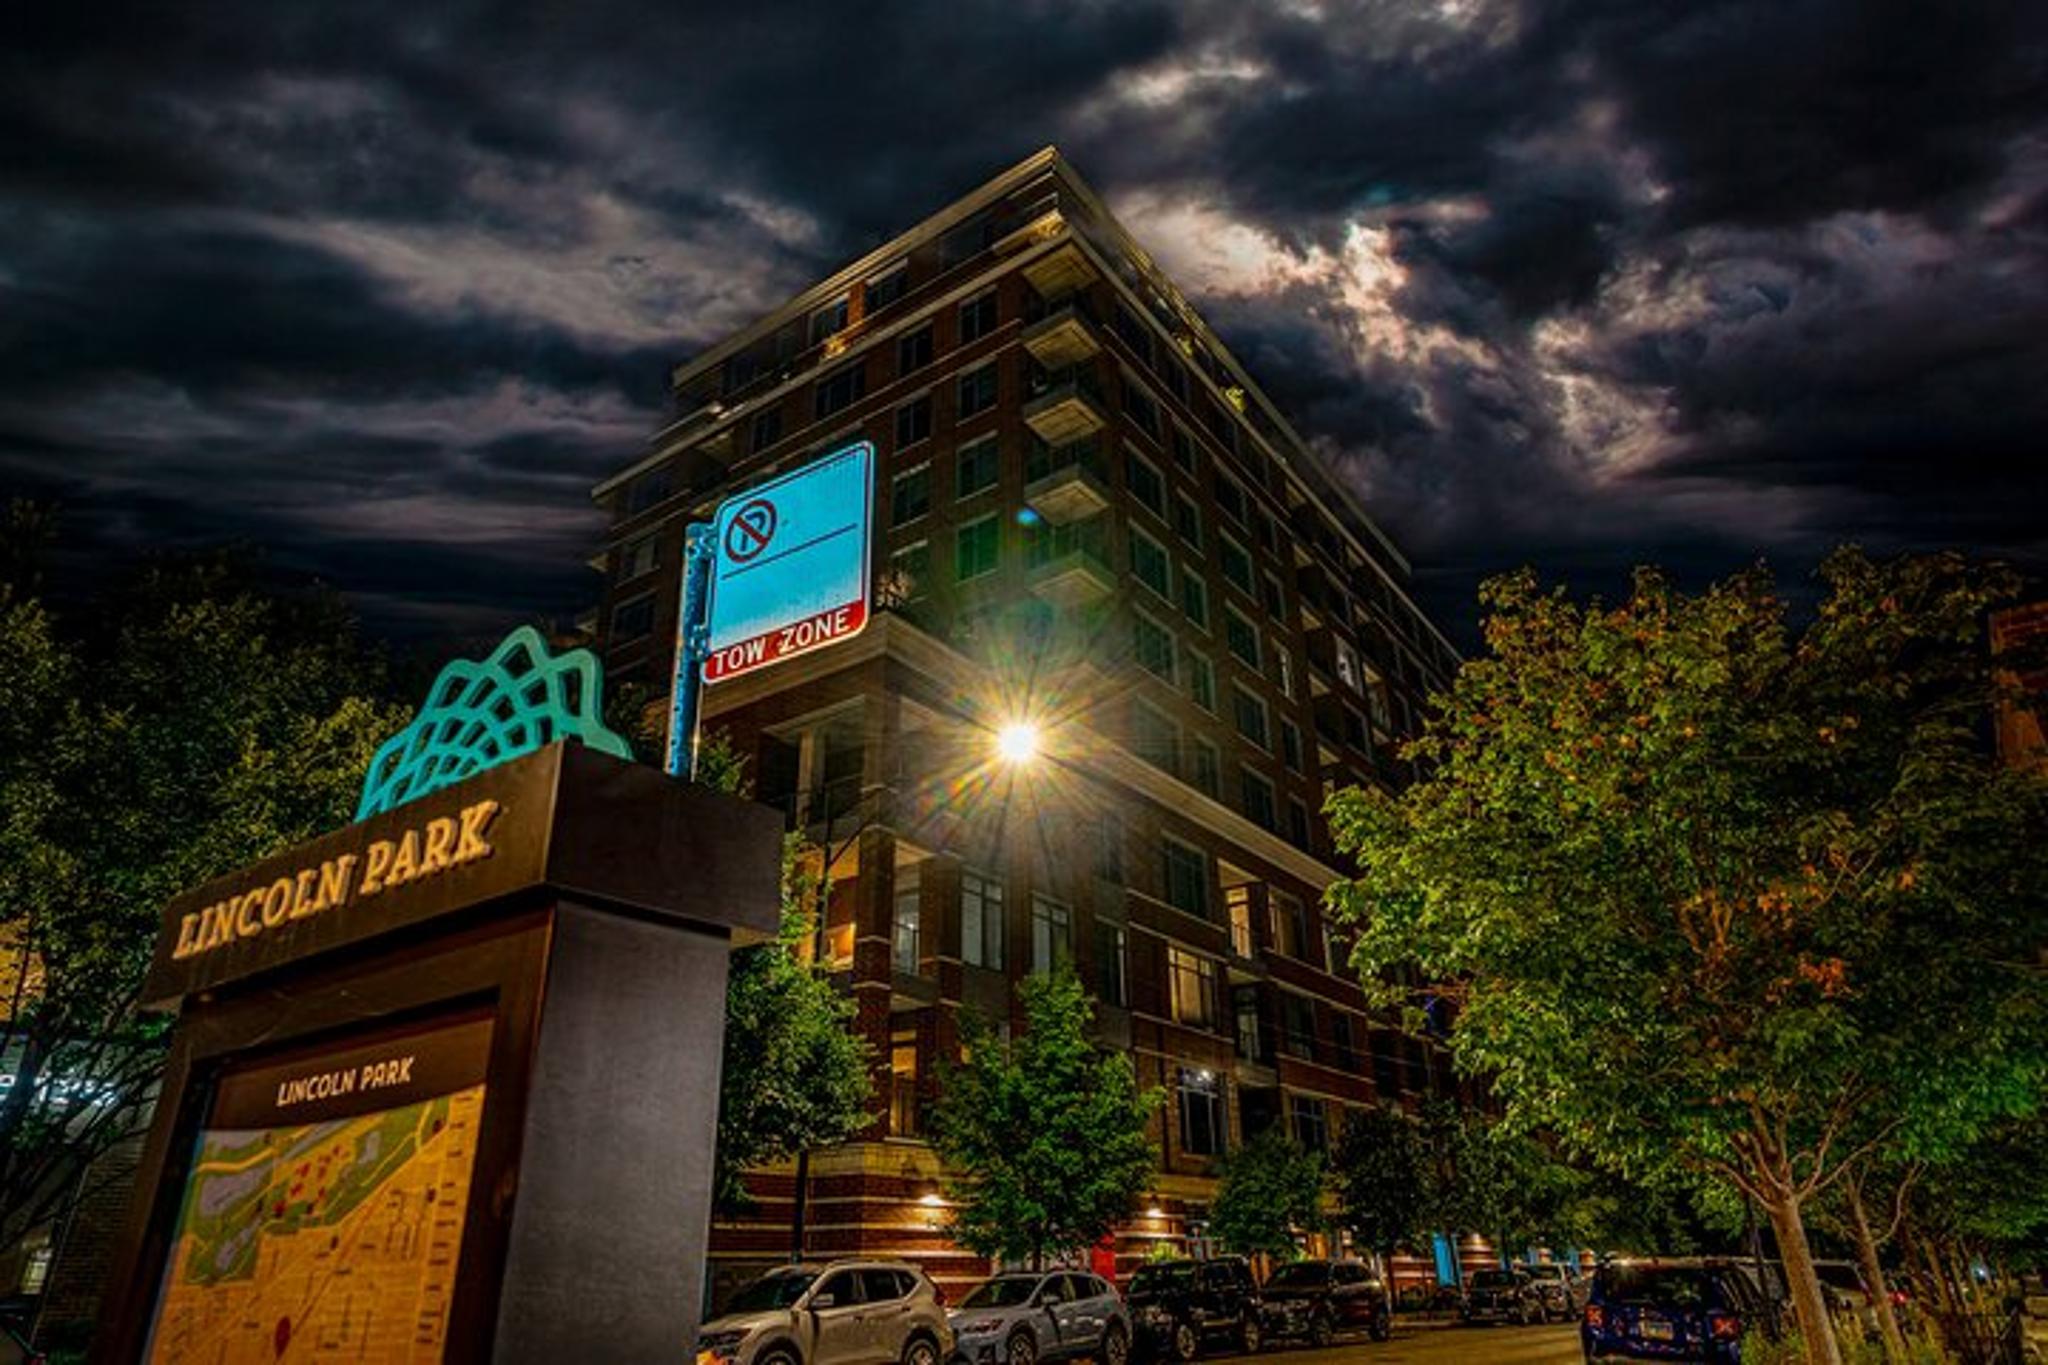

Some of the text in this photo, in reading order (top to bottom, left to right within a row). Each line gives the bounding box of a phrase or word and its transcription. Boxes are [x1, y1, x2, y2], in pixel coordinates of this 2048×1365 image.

[714, 607, 850, 675] TOW ZONE
[172, 800, 499, 960] LINCOLN PARK
[276, 1056, 415, 1107] LINCOLN PARK
